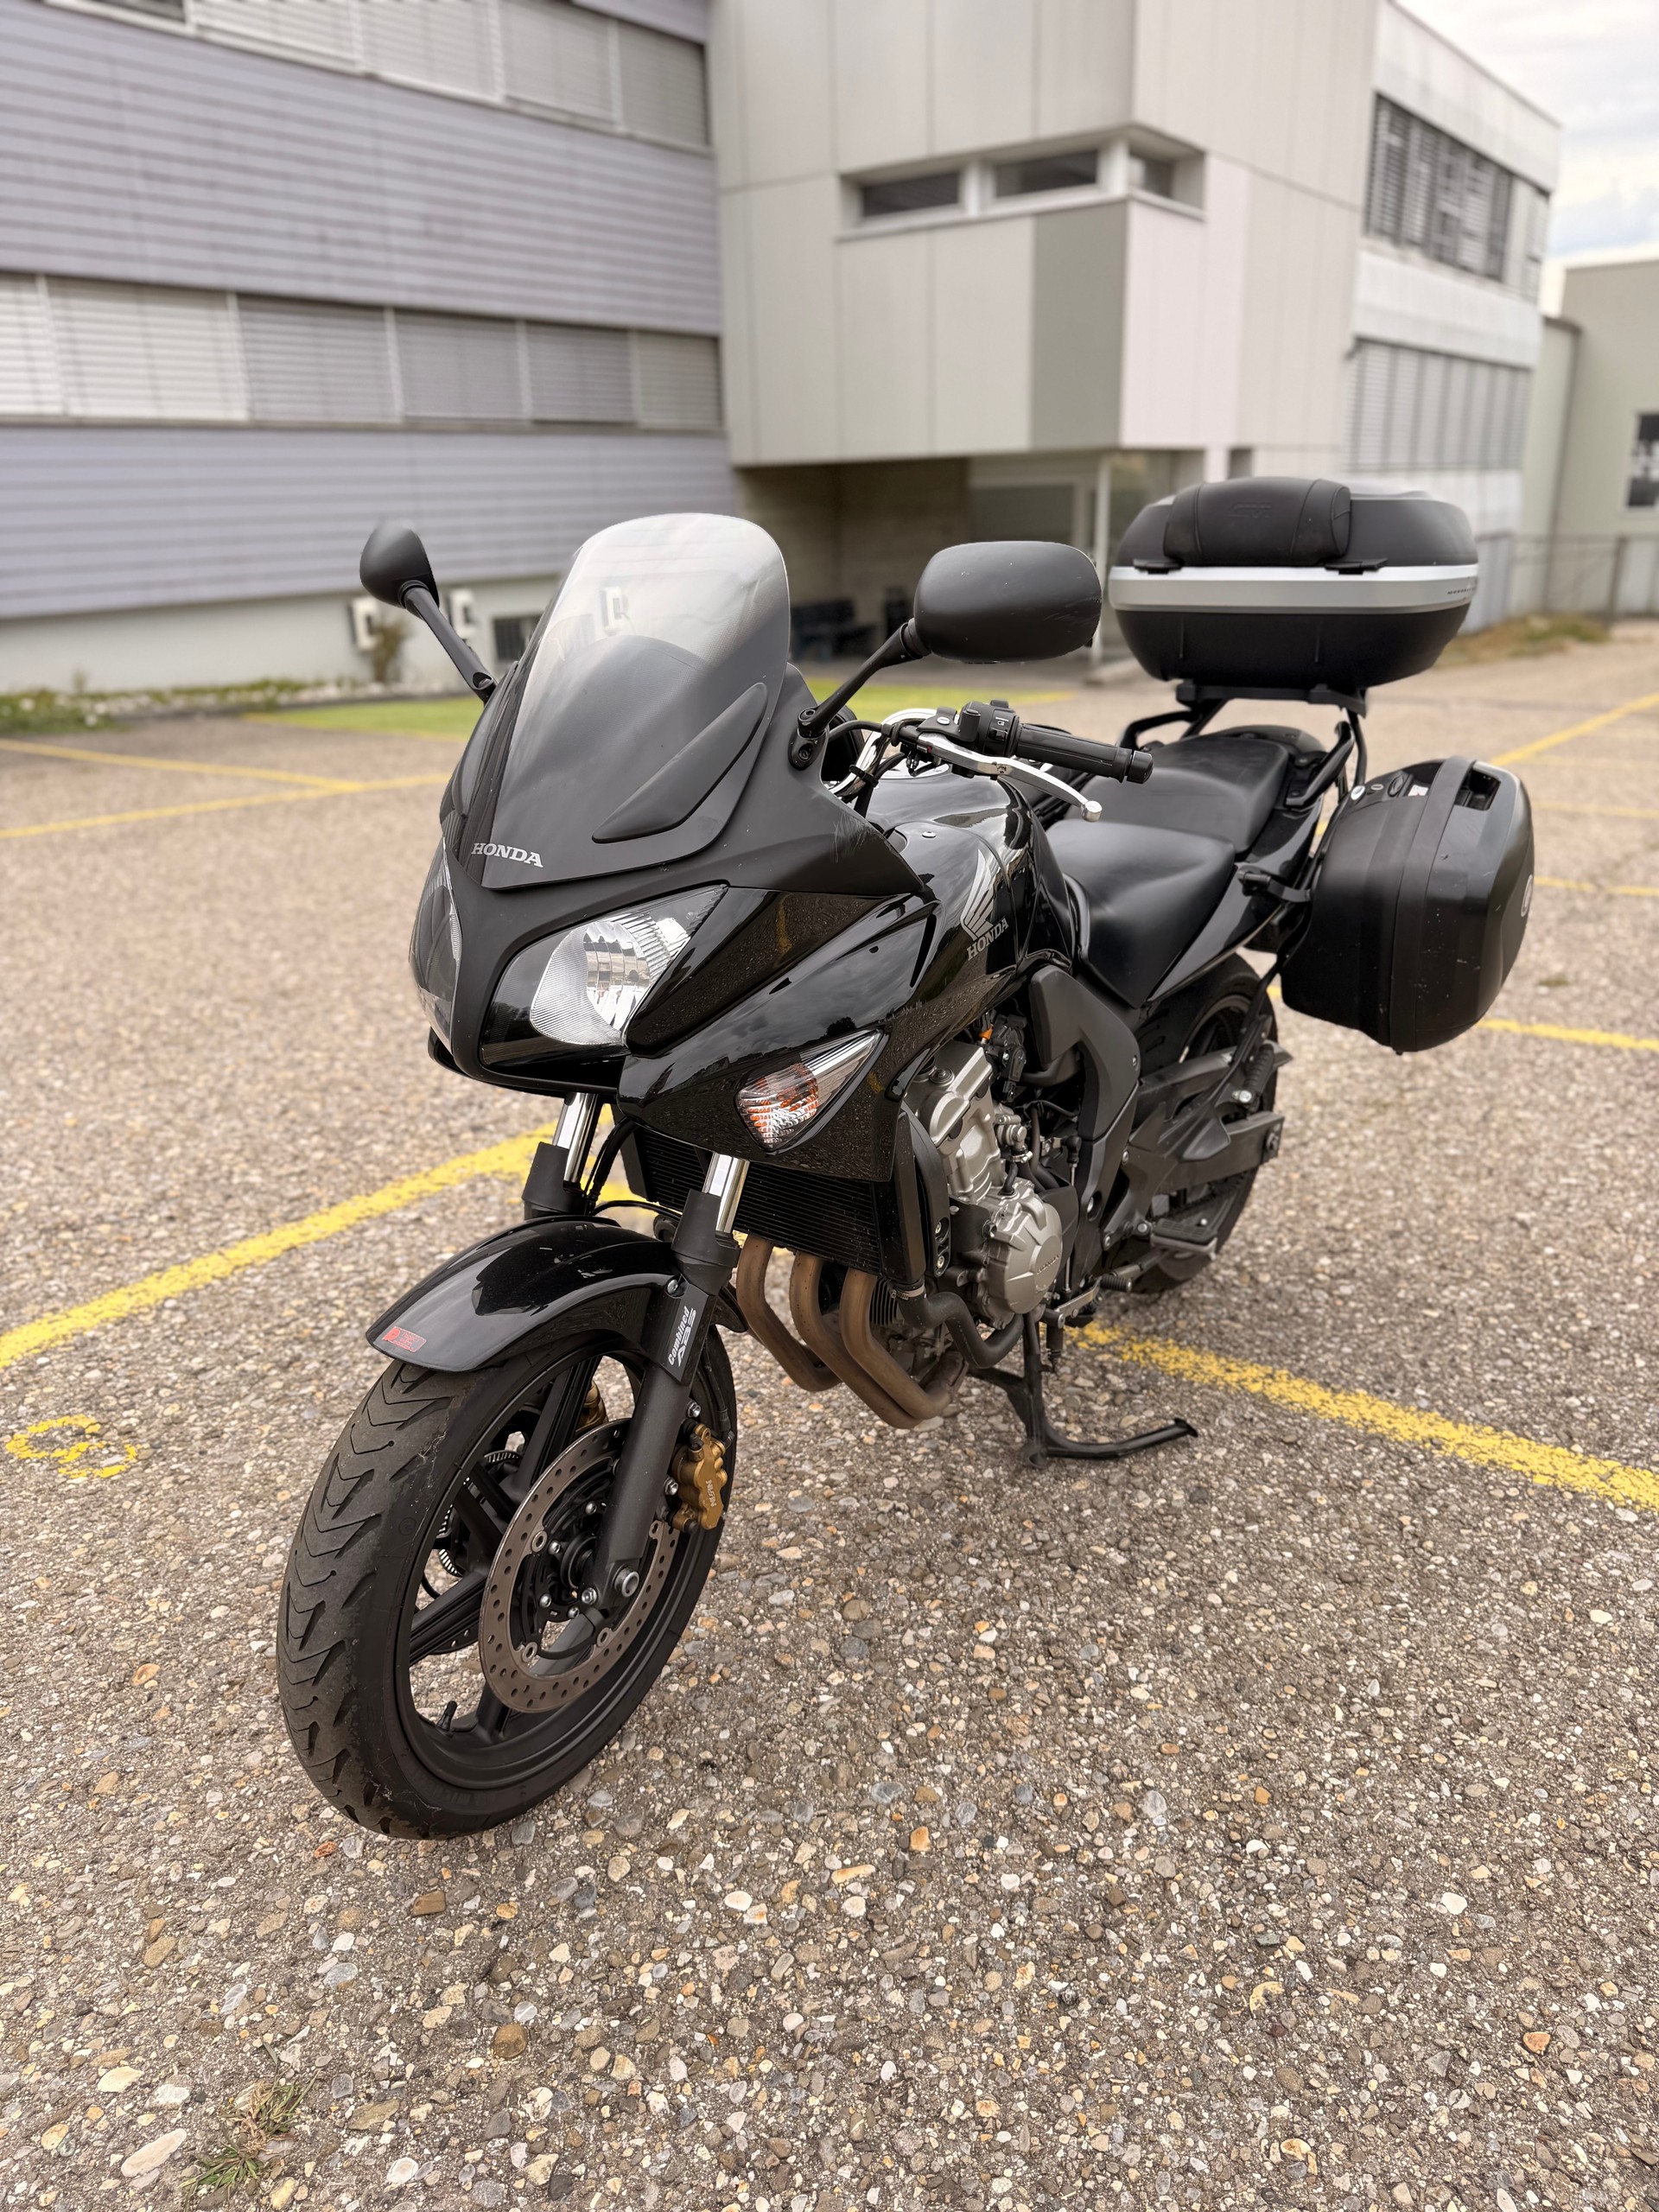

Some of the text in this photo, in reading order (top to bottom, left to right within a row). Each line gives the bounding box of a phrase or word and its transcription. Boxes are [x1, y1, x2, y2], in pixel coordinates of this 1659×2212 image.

[471, 842, 544, 868] HONDA
[966, 916, 1009, 961] HONDA
[668, 1305, 690, 1366] Combined
